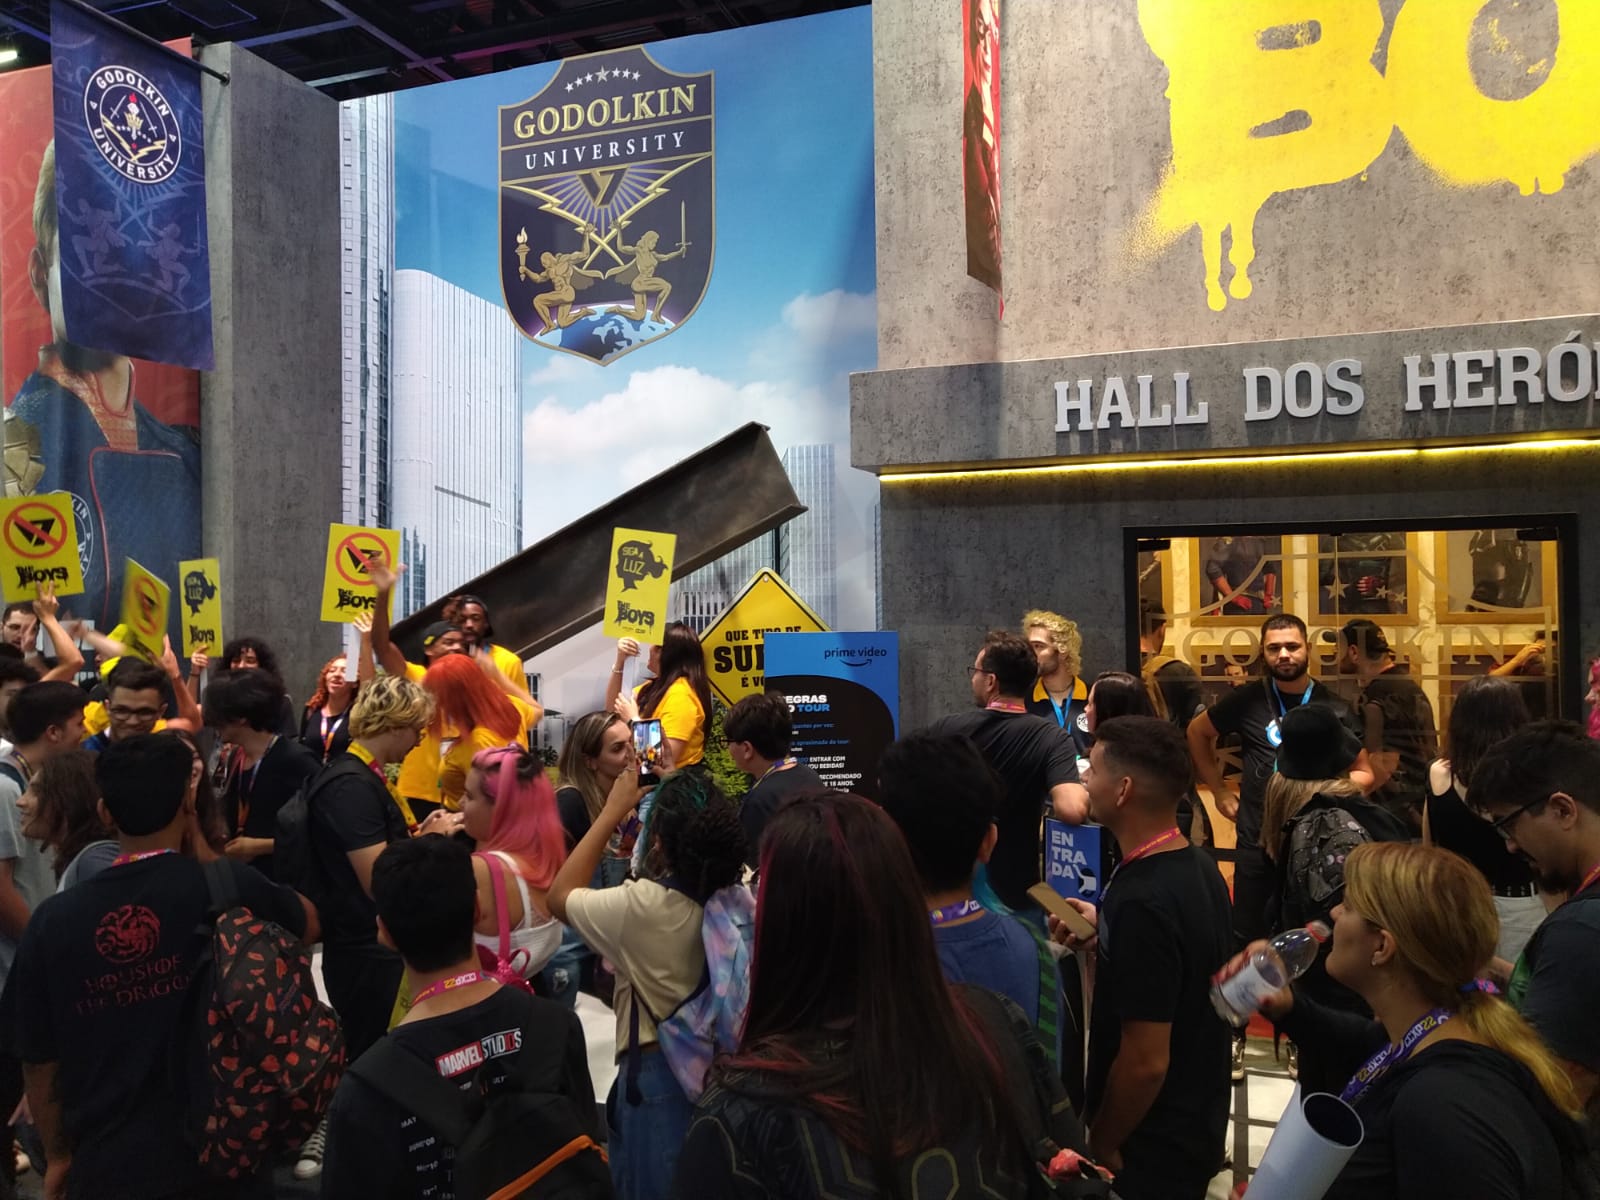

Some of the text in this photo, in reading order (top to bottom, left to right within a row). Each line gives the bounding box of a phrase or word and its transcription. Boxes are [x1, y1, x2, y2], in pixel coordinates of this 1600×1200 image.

[96, 69, 171, 117] GODOLKIN
[513, 83, 697, 139] GODOLKIN
[93, 127, 175, 180] UNIVERSITY
[524, 131, 685, 170] UNIVERSITY
[1054, 330, 1600, 432] HALL DOS HERÓ
[623, 558, 646, 576] LUZ
[615, 607, 655, 628] BOYS
[725, 629, 749, 642] QUE
[1182, 625, 1505, 667] GOOLKIN
[824, 646, 887, 659] prime video
[741, 674, 749, 688] É
[784, 694, 827, 704] EGRAS
[797, 703, 830, 712] TOUR
[1051, 830, 1074, 847] EN
[1051, 845, 1088, 866] TRA
[1051, 861, 1075, 880] DA
[115, 971, 193, 1008] DRAGO
[437, 1030, 522, 1077] MARVEL STUDIOS
